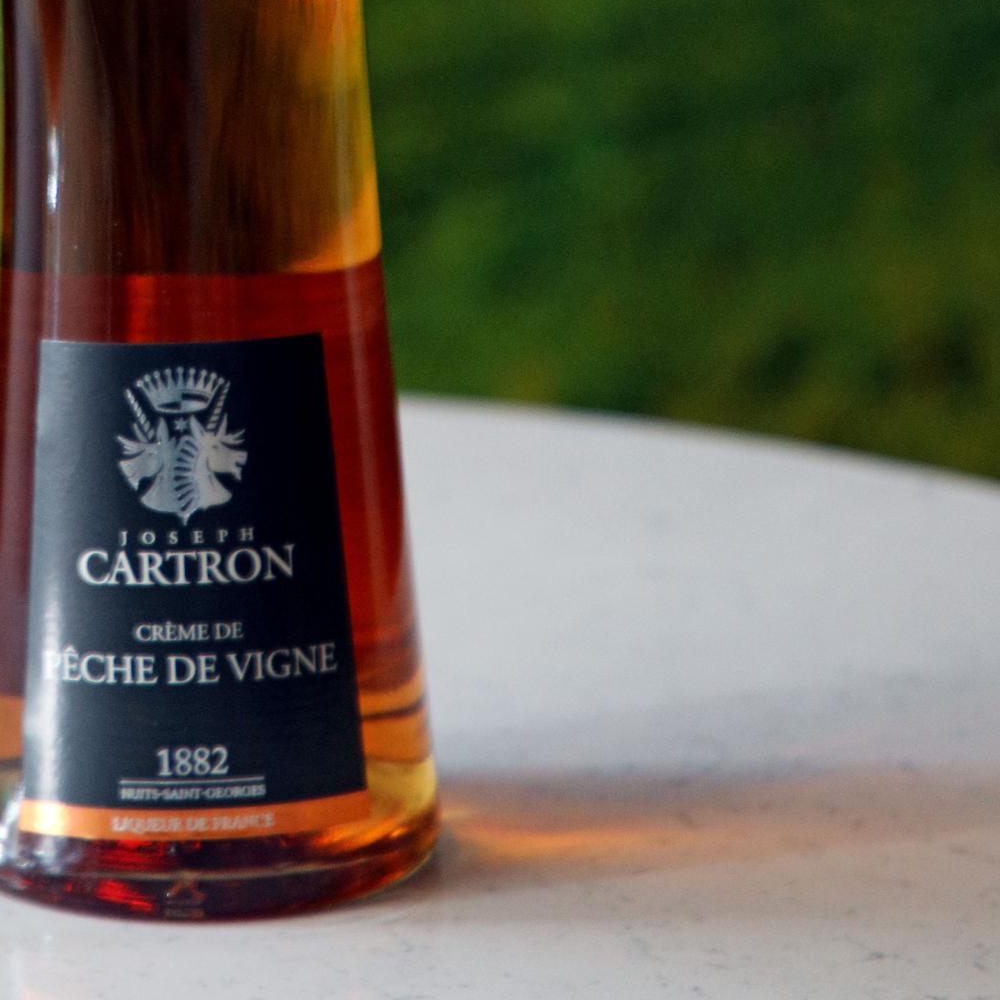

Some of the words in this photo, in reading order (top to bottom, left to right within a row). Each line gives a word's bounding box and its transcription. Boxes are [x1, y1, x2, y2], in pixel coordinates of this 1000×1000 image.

[119, 527, 255, 547] JOSEPH
[76, 544, 295, 586] CARTRON
[133, 621, 210, 642] CRÈME
[214, 622, 244, 640] DE
[43, 645, 158, 684] PÊCHE
[166, 654, 220, 684] DE
[226, 642, 338, 681] VIGNE
[157, 746, 229, 776] 1882
[111, 816, 182, 834] LIQUEUR
[185, 816, 208, 832] DE
[212, 811, 277, 831] FRANCE
